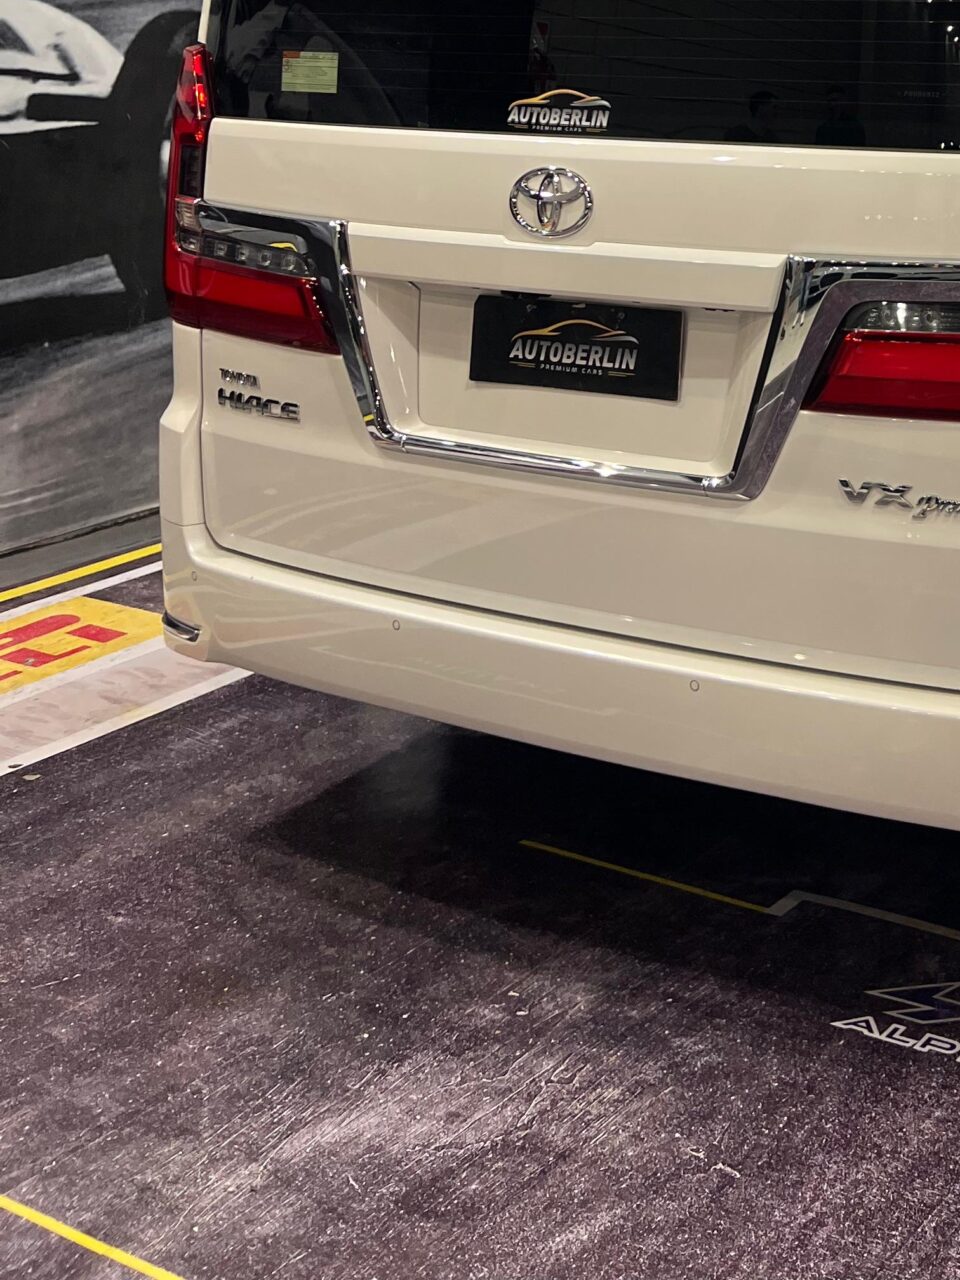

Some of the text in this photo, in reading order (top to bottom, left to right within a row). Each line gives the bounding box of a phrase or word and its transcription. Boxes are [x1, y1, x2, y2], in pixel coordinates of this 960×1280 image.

[507, 106, 610, 128] AUTOBERLIN
[509, 338, 638, 370] AUTOBERLIN
[540, 363, 603, 376] PREMIUM CARS
[217, 387, 301, 422] HIACE
[838, 478, 913, 509] VX
